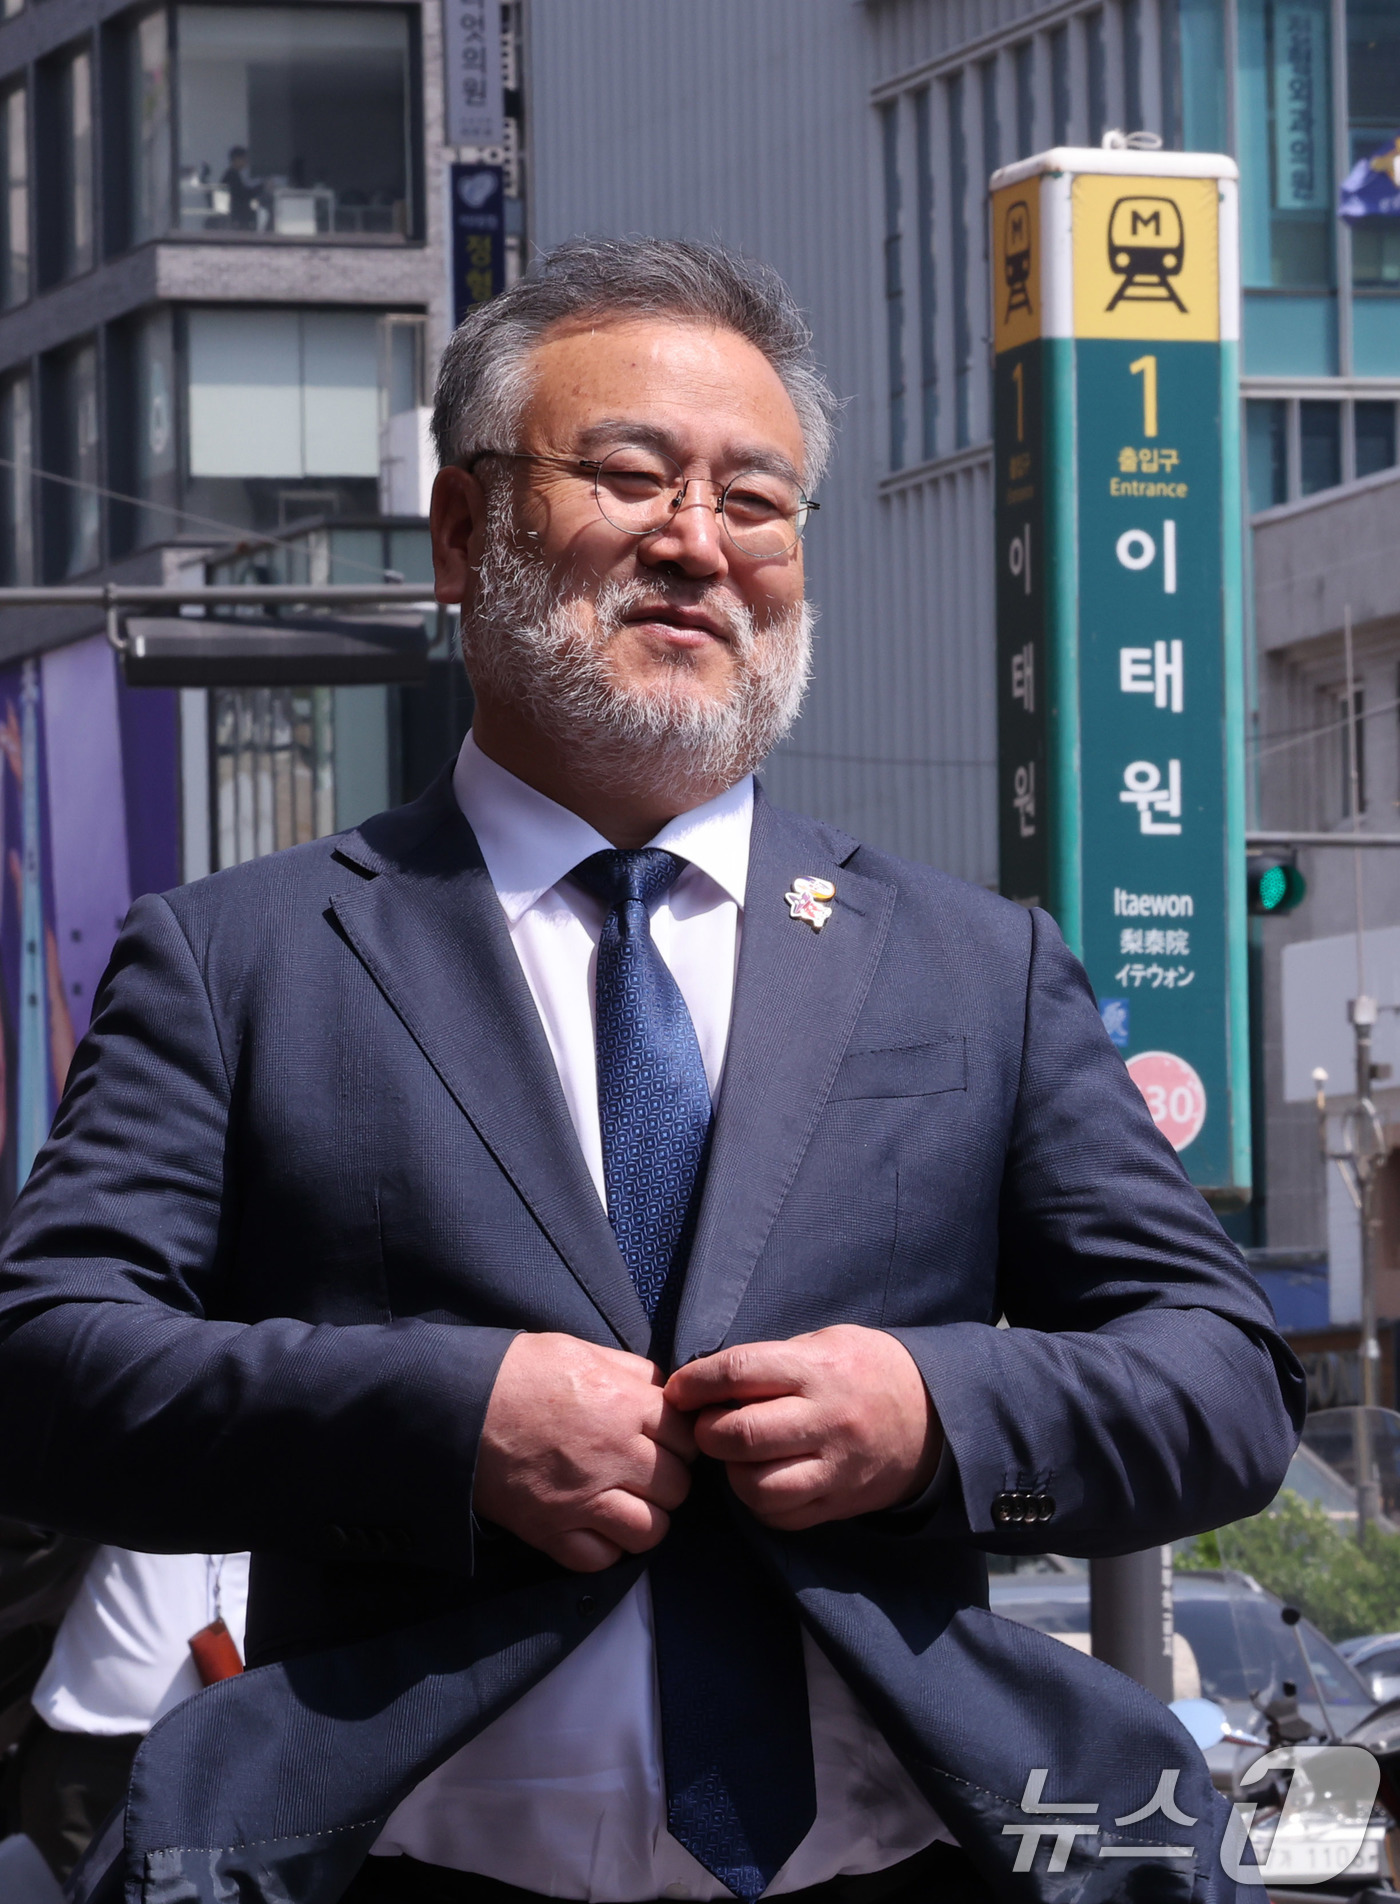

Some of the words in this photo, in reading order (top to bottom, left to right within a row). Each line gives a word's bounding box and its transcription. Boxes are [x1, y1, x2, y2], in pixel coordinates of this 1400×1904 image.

[1011, 362, 1024, 442] 1
[1129, 355, 1158, 438] 1
[1118, 446, 1180, 473] 출입구
[1109, 477, 1189, 498] Entrance
[1009, 522, 1036, 838] 이태원
[1115, 519, 1184, 835] 이태원
[1113, 887, 1194, 917] Itaewon
[1120, 928, 1191, 956] 梨泰院
[1114, 962, 1196, 989] イテウォン
[1146, 1085, 1195, 1124] 30
